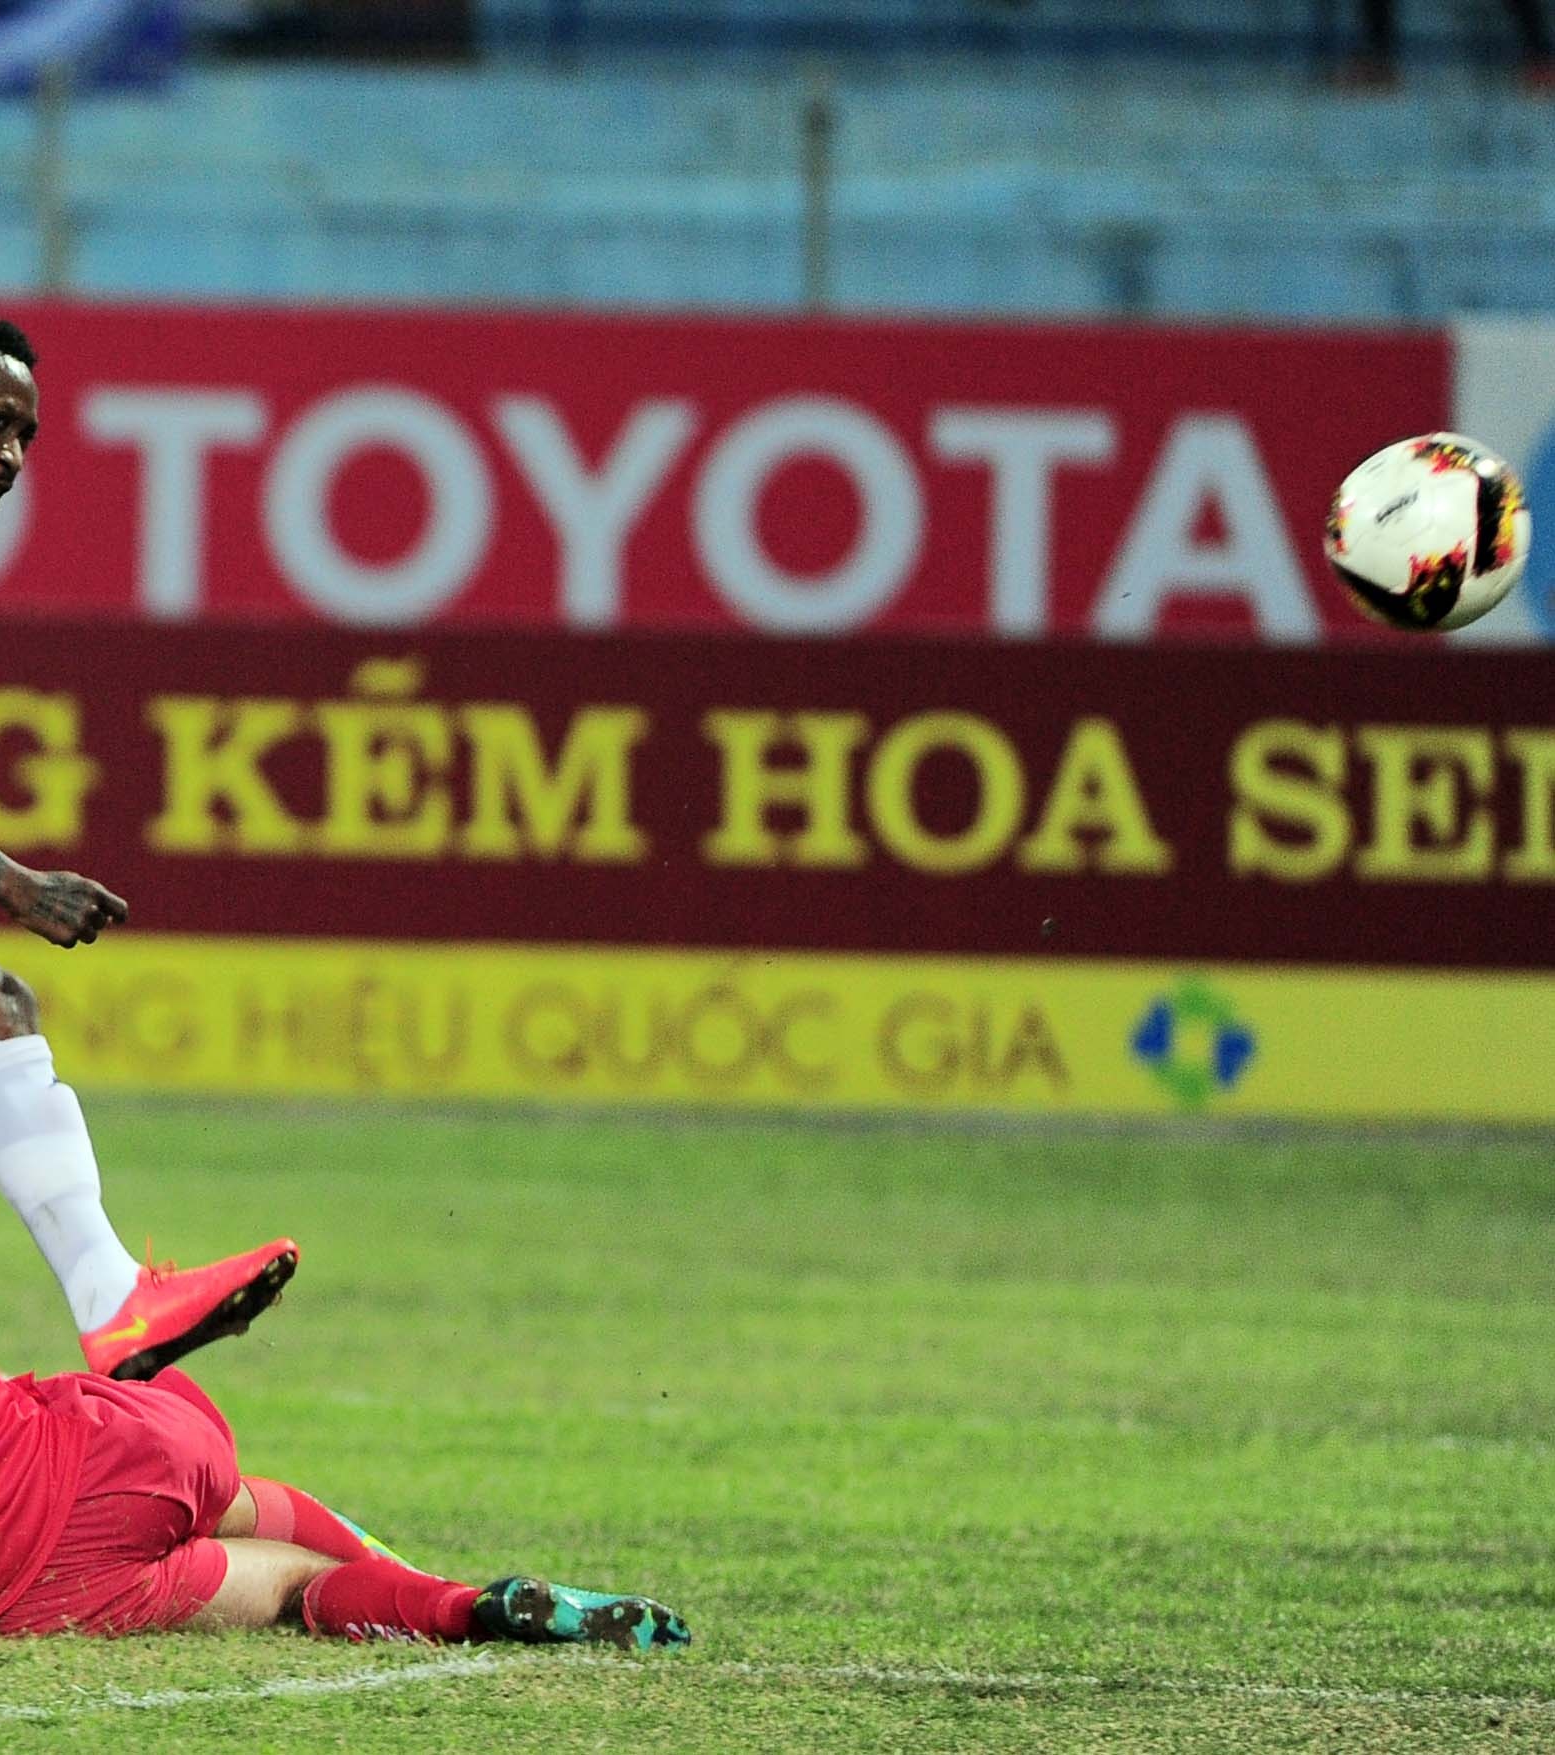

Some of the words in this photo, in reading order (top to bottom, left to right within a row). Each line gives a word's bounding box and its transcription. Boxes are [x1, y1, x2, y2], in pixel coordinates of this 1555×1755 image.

[80, 383, 1323, 643] TOYOTA
[704, 709, 1172, 874] HOA
[495, 954, 840, 1093] QUỐC
[873, 989, 1072, 1096] GIA
